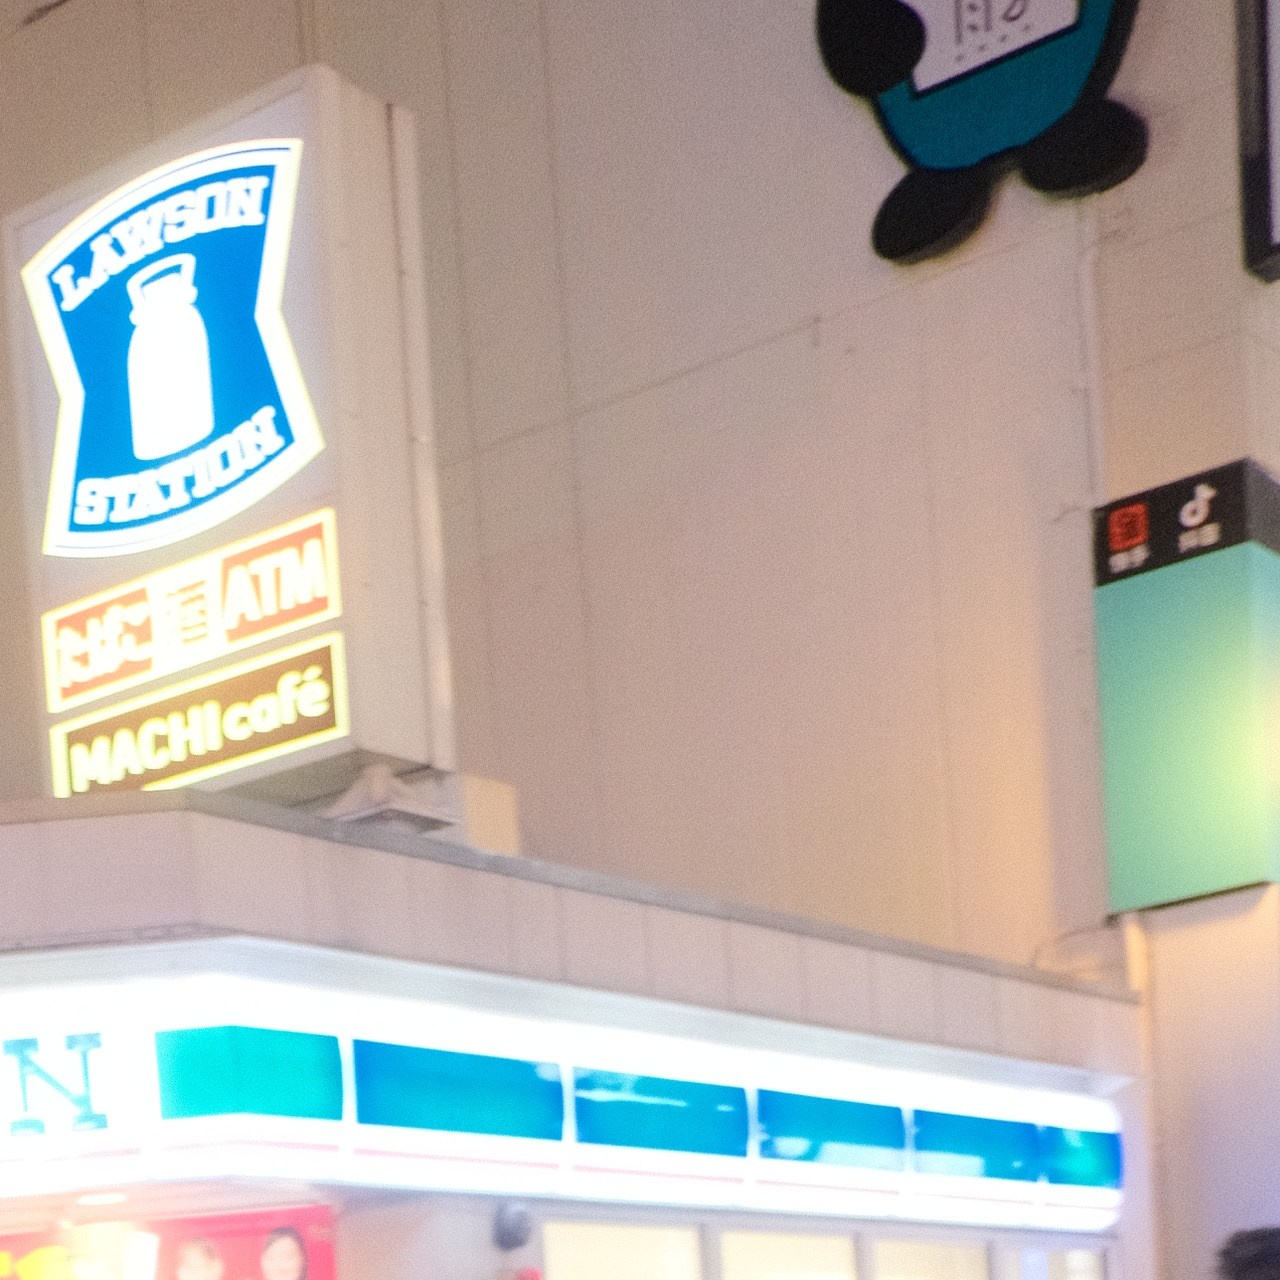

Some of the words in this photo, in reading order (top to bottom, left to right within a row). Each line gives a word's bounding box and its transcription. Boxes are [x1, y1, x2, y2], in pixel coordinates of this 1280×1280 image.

[52, 177, 269, 312] LAWSON
[73, 406, 285, 526] STATION
[224, 538, 326, 630] ATM
[70, 700, 223, 793] MACHI
